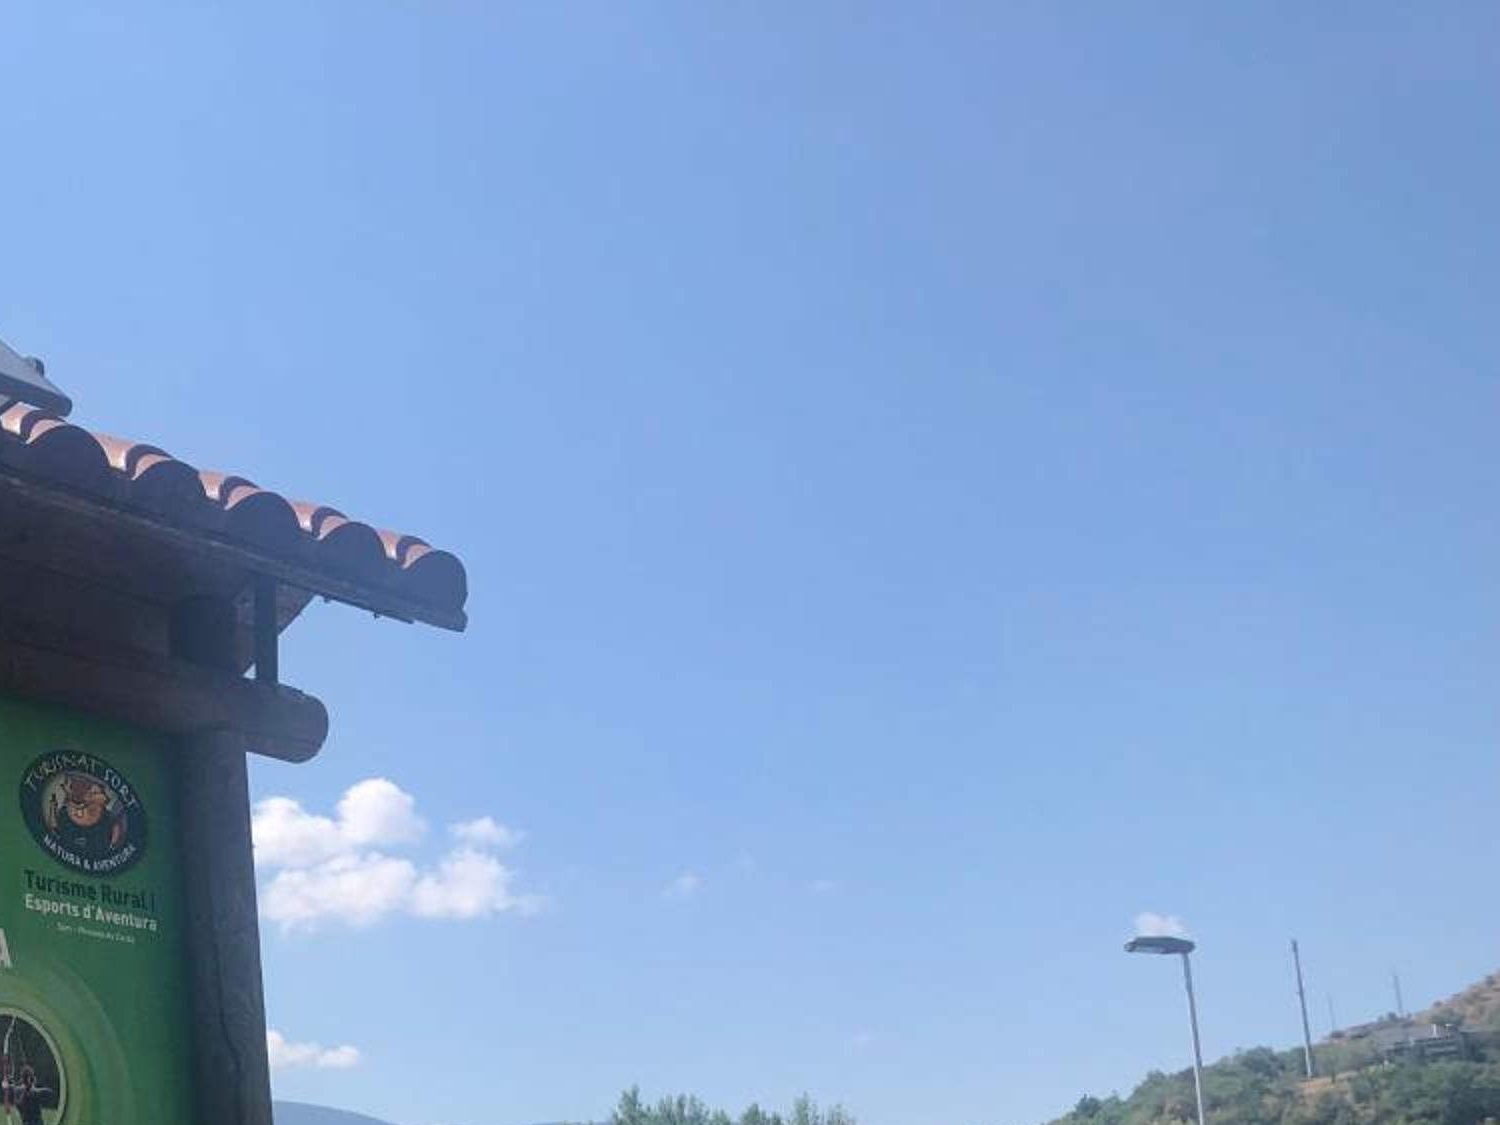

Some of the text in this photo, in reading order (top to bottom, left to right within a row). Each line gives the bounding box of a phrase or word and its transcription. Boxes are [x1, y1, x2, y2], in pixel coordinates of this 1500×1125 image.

[24, 753, 137, 807] TURISNAT SORT
[24, 869, 96, 899] Turisme
[101, 884, 148, 910] Rural
[25, 893, 157, 931] Esports d'Aventura
